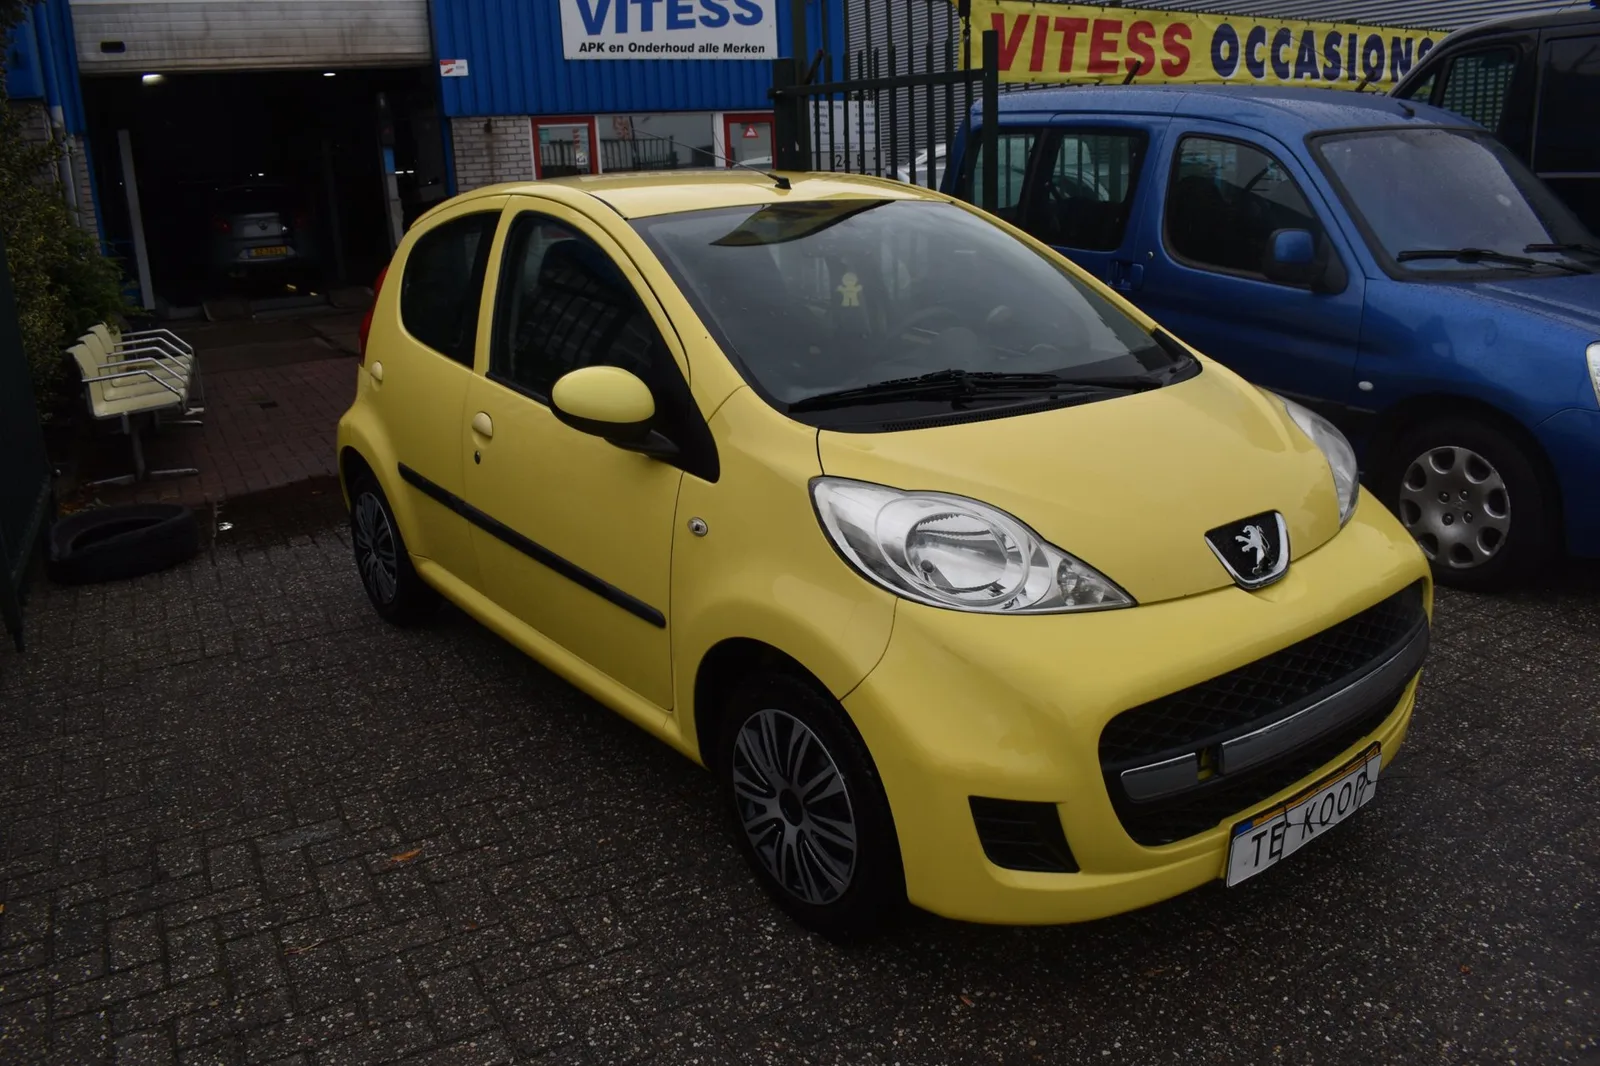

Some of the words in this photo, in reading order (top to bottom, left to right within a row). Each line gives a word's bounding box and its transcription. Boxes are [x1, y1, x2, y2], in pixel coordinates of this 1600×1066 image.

[575, 0, 764, 36] VITESS
[578, 42, 605, 53] APK
[609, 44, 624, 53] en
[628, 42, 695, 53] Onderhoud
[698, 43, 720, 53] alle
[723, 43, 765, 53] Merken
[990, 12, 1193, 78] VITESS
[1251, 821, 1286, 867] TE
[1301, 772, 1368, 840] KOOP
